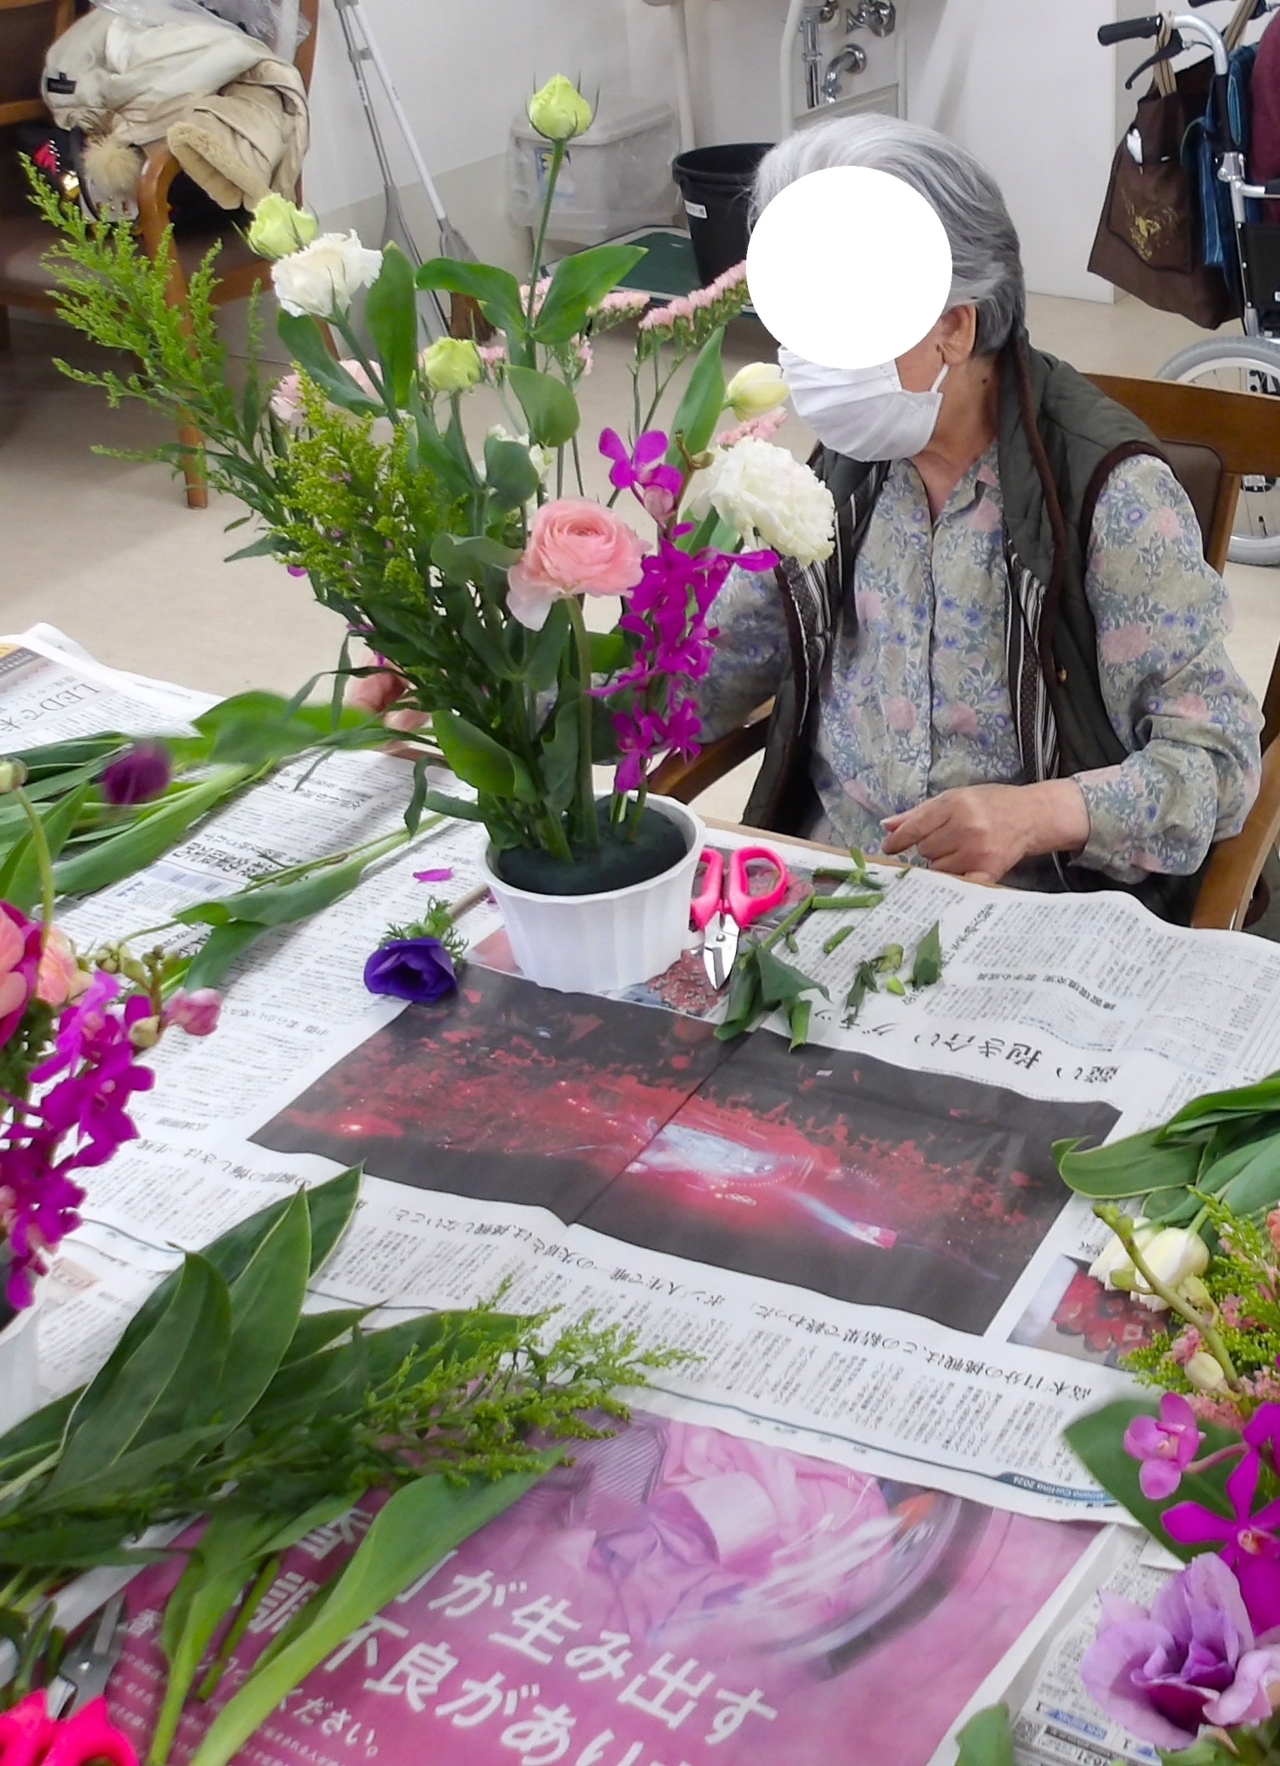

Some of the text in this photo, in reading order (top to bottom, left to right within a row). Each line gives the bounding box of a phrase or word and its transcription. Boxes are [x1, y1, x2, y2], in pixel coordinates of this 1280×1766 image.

[913, 1031, 1044, 1071] 抱き合い
[1054, 1063, 1119, 1087] 競い
